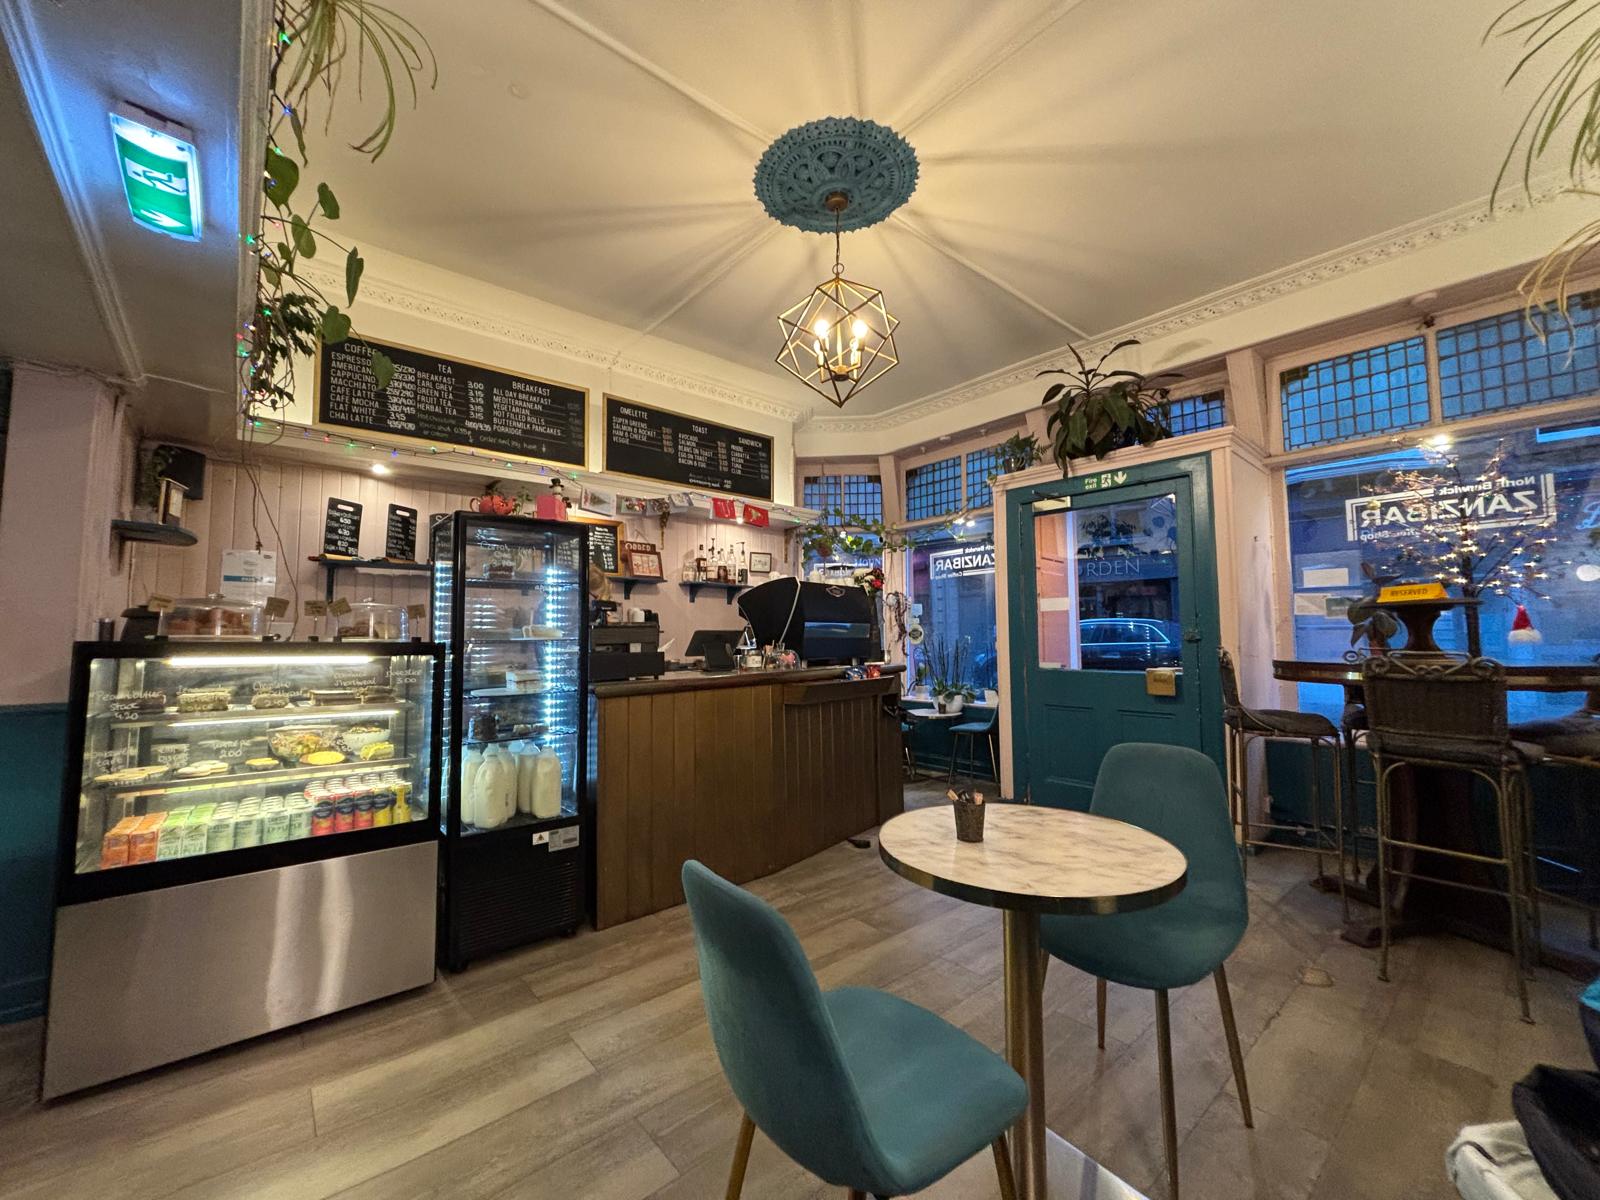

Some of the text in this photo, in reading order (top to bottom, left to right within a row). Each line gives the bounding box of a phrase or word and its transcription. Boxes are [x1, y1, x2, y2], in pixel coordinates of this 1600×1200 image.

[331, 352, 371, 366] ESPRESSO
[331, 361, 375, 374] AMERICAN
[438, 364, 452, 374] TEA
[330, 369, 376, 383] CAPPUCINO
[416, 371, 456, 385] BREAKFAST
[330, 378, 376, 390] MACCHIATO
[416, 379, 434, 388] EARL
[435, 382, 453, 391] GREY
[512, 381, 550, 397] BREAKFAST
[330, 385, 350, 394] CAFE
[352, 389, 376, 400] LATTE
[416, 386, 439, 397] GREEN
[440, 391, 454, 400] TEA
[504, 390, 517, 398] DAY
[518, 392, 552, 406] BREAKFAST
[330, 394, 350, 404] CAFE
[352, 398, 379, 408] MOCHA
[416, 395, 438, 404] FRUIT
[439, 399, 452, 408] TEA
[492, 396, 542, 412] MEDITERRANEAN
[330, 402, 348, 412] FLAT
[352, 406, 376, 416] WHITE
[416, 402, 442, 414] HERBAL
[445, 407, 457, 416] TEA
[492, 404, 530, 416] VEGETARIAN
[620, 406, 648, 420] OMELETTE
[330, 411, 348, 420] CHAI
[350, 414, 374, 424] LATTE
[492, 410, 545, 426] HOT FILLED ROLLS
[492, 418, 561, 436] BUTTERMILK PANCAKES
[492, 425, 522, 436] PORRIDGE
[692, 425, 708, 434] TOAST
[1390, 588, 1428, 597] RESERVED
